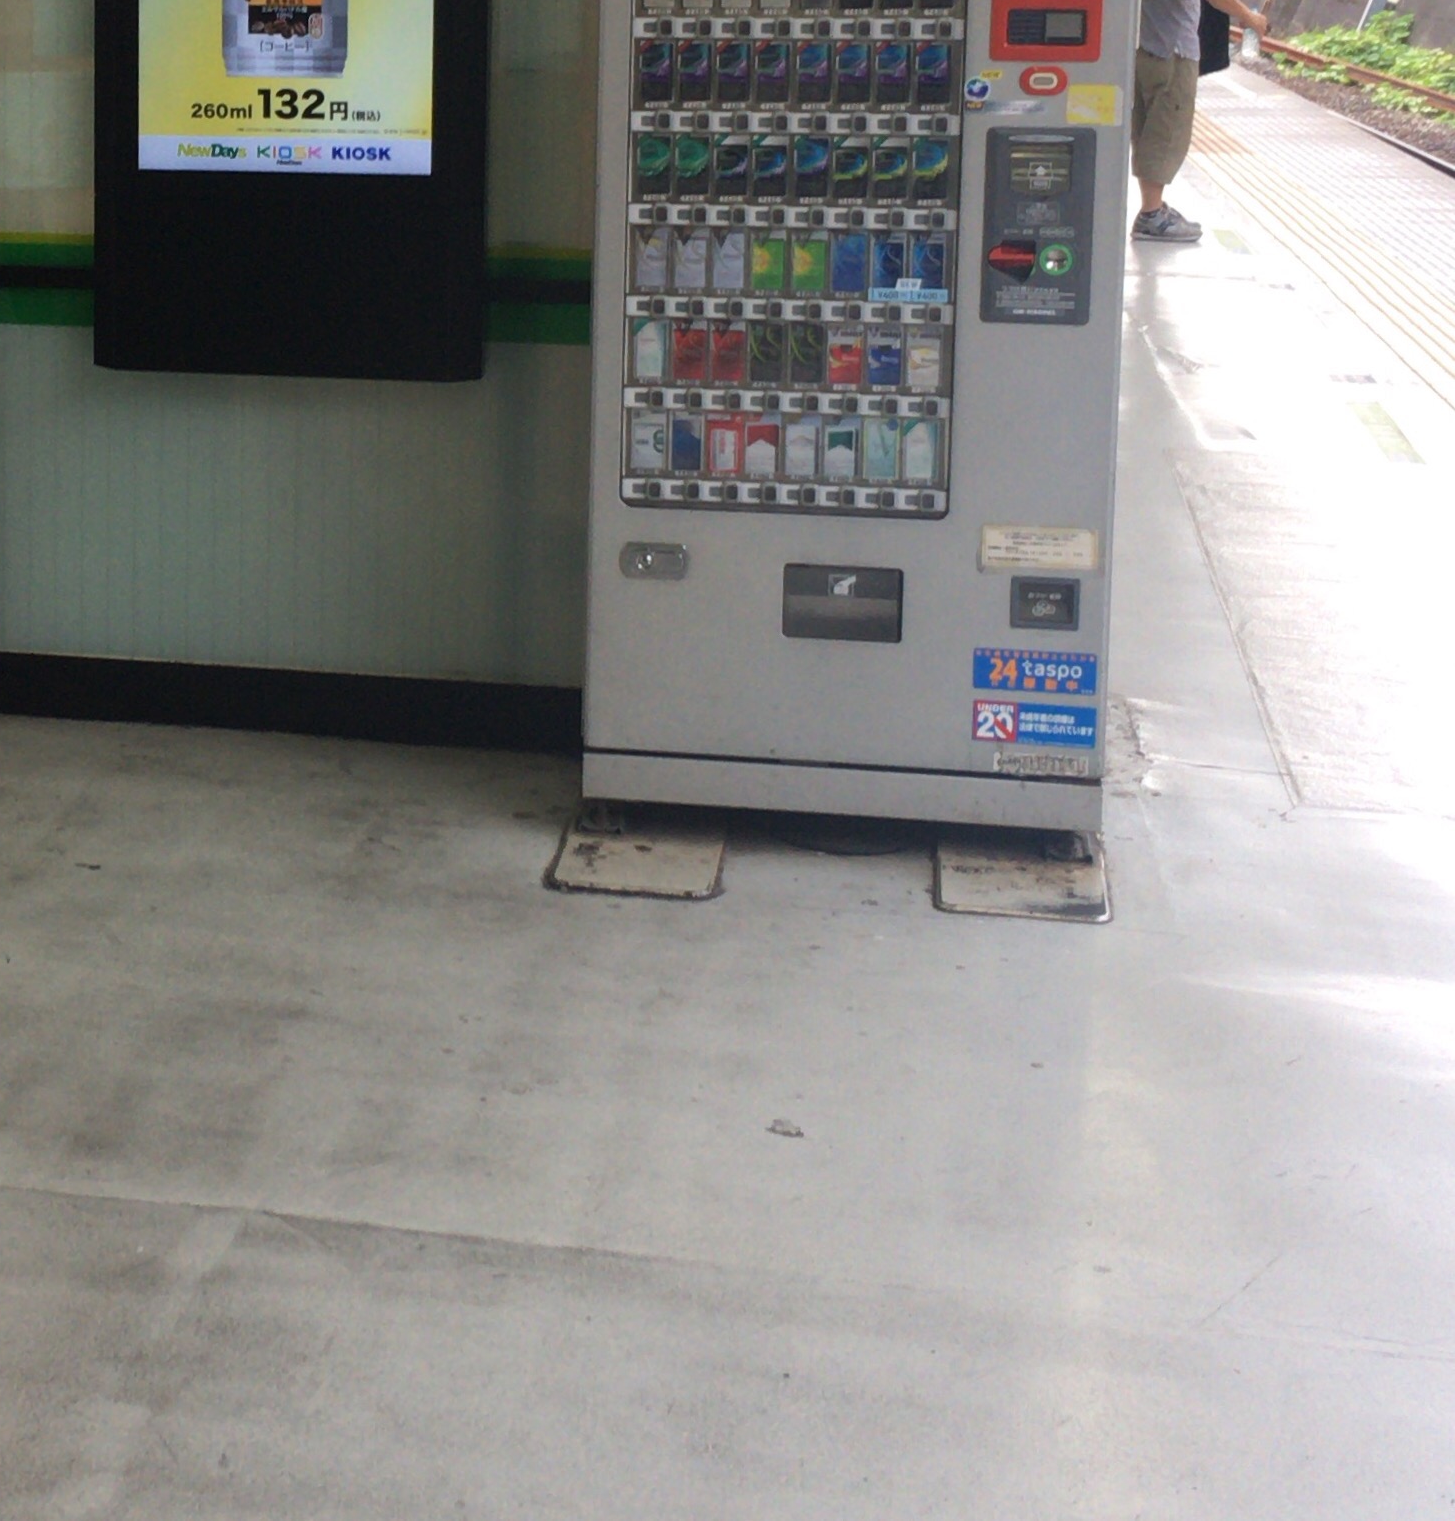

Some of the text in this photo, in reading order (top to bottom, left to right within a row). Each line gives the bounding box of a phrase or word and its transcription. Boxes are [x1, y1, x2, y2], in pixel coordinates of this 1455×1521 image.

[191, 103, 253, 120] 260ml
[176, 142, 392, 162] NewDays KIOSK KIOSK
[989, 657, 1083, 682] 24 taspo
[977, 702, 1014, 713] UNDER
[976, 710, 1014, 740] 20
